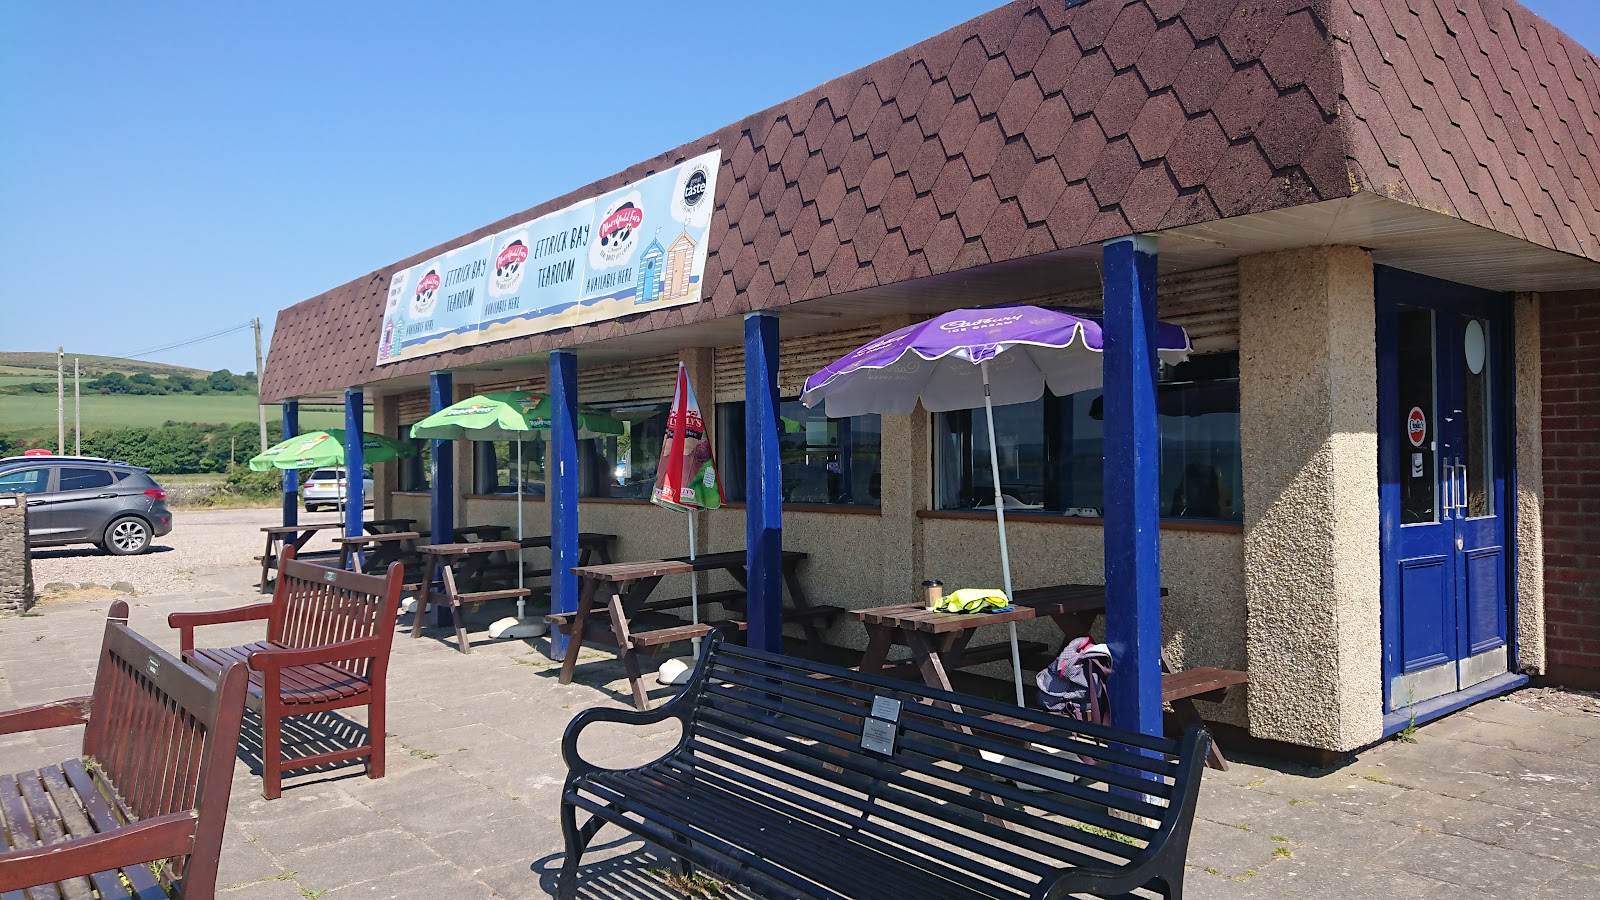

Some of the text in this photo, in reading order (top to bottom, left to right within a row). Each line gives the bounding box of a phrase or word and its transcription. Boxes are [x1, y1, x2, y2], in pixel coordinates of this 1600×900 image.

[685, 182, 706, 197] taste
[534, 224, 590, 259] ETTRICK BAY
[444, 263, 472, 288] ETTRICK
[471, 258, 487, 280] BAY
[537, 258, 576, 288] TEAROOM
[586, 267, 633, 294] AVAILABLE HERE
[446, 287, 475, 312] TEAROOM
[484, 296, 520, 316] AVAILABLE HERE
[939, 314, 1024, 331] Cadbury
[972, 320, 1013, 330] CREAM
[685, 417, 702, 428] LY'S
[685, 429, 698, 438] Here
